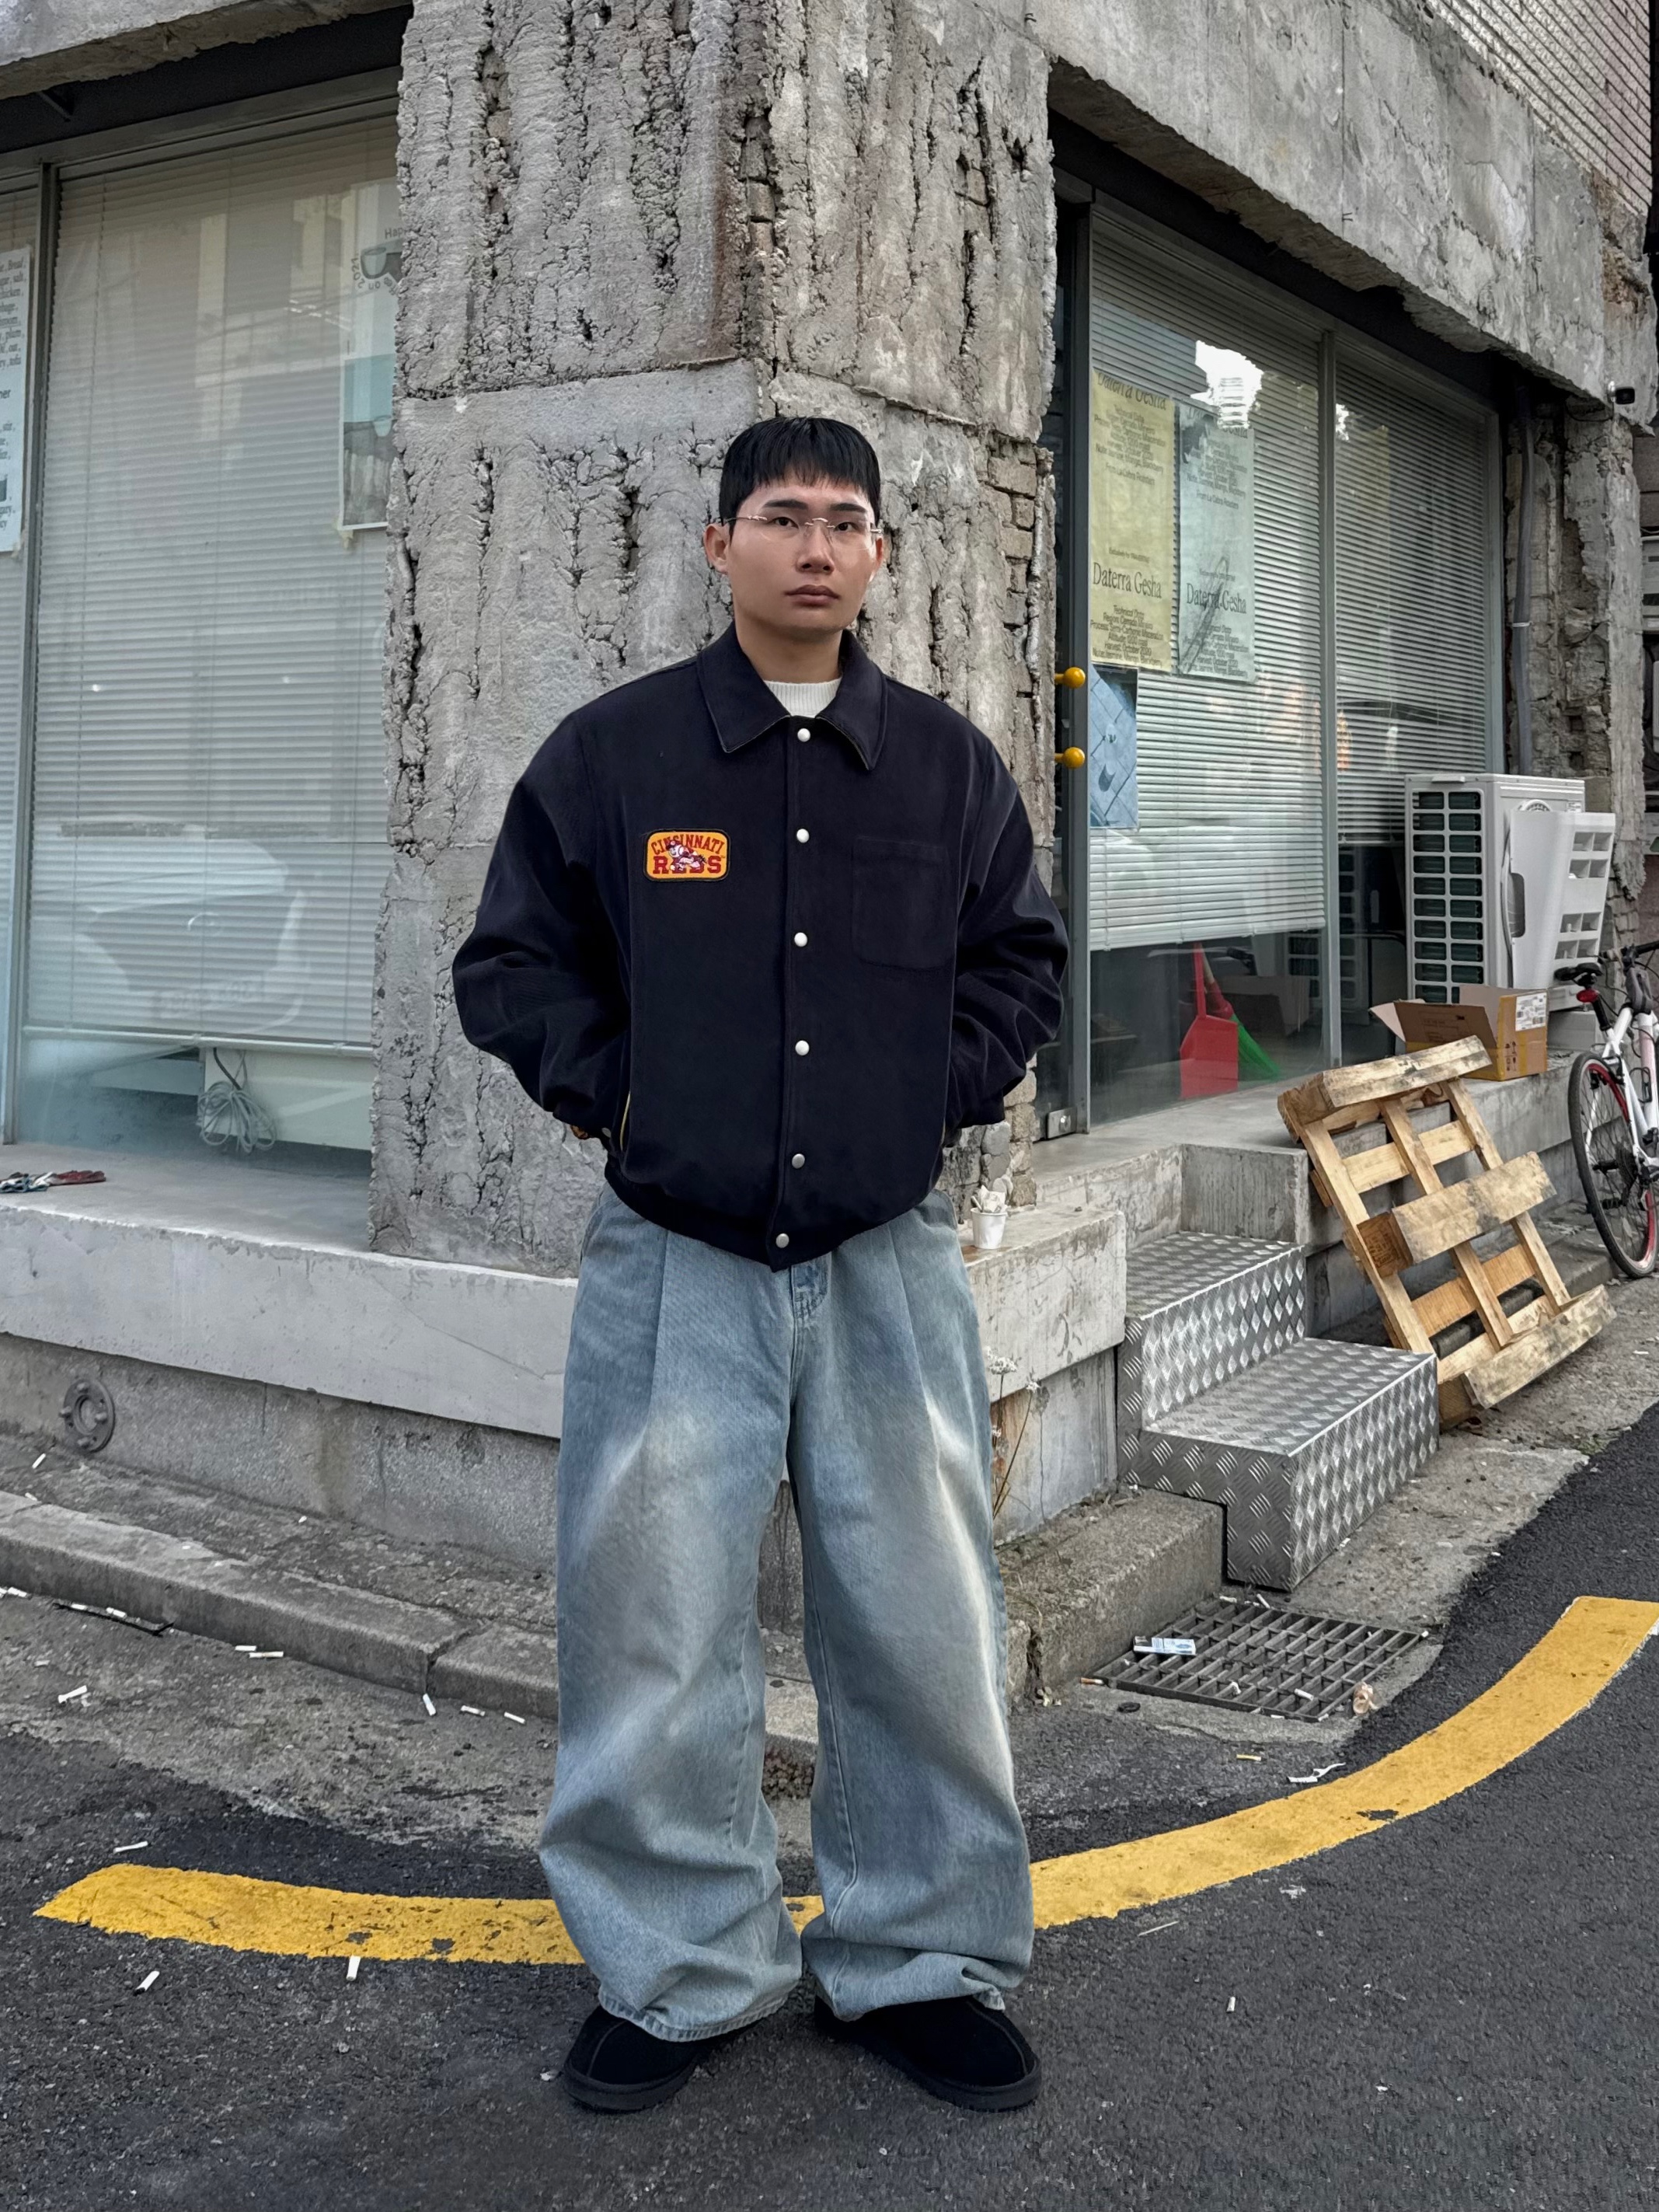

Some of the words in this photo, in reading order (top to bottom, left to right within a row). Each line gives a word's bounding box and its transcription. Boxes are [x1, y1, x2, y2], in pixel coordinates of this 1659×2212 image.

[1093, 562, 1132, 592] Daterra
[1134, 571, 1162, 598] Gesha
[1187, 583, 1221, 609] Daterra
[1222, 590, 1247, 614] Gesha
